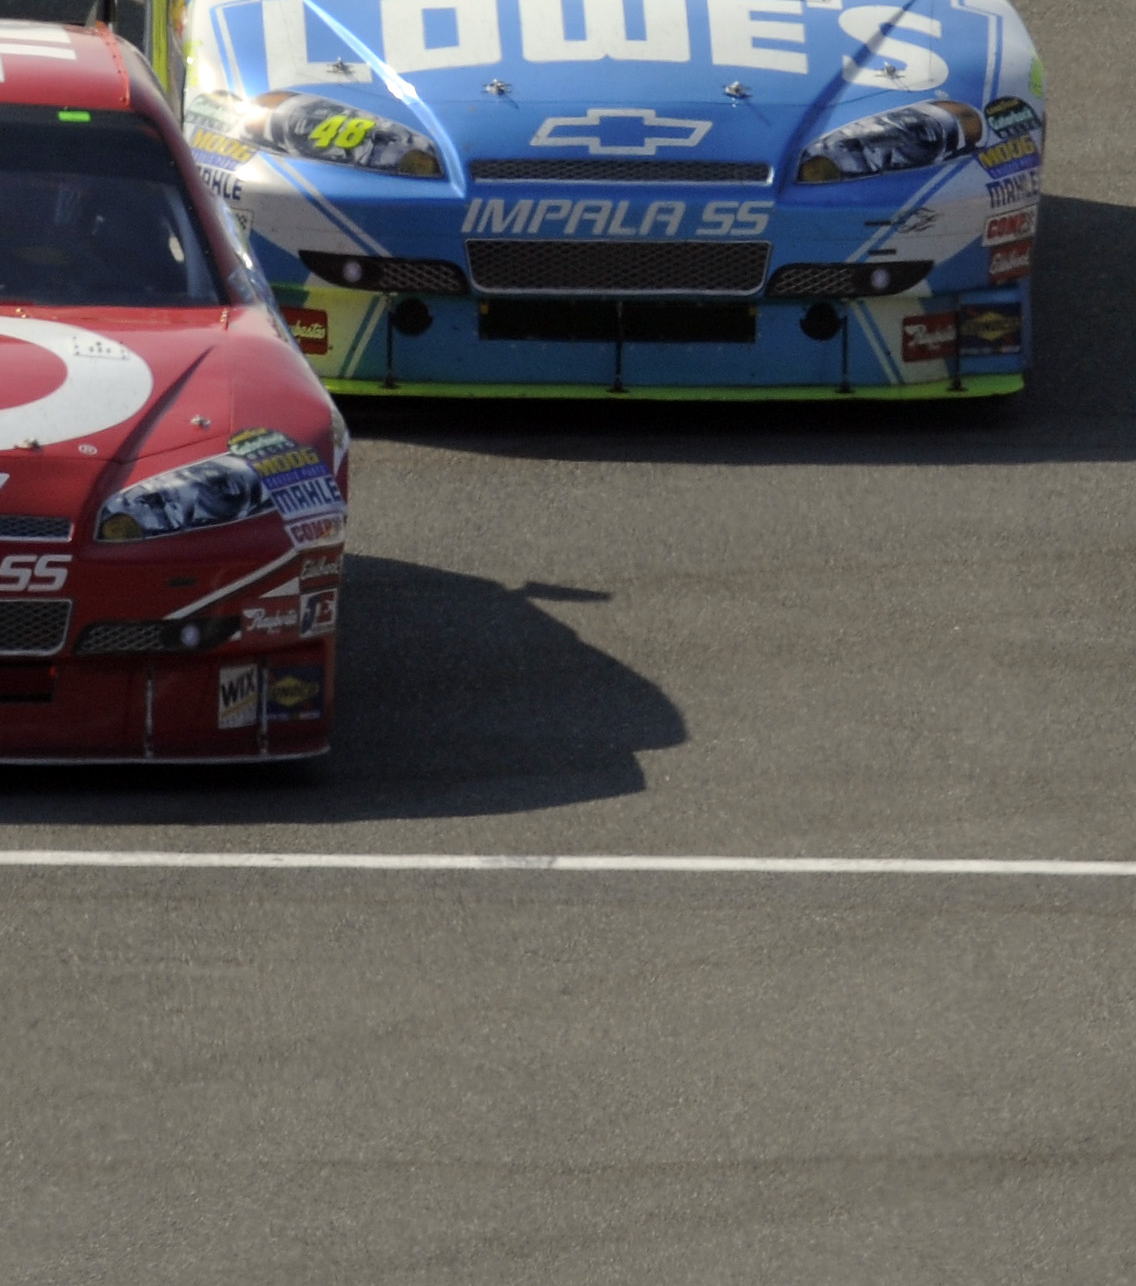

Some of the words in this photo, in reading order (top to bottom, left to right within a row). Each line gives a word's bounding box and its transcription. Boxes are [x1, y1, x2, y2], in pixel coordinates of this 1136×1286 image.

[192, 129, 253, 162] MOOG
[309, 116, 376, 149] 48
[978, 134, 1036, 169] MOOG
[197, 166, 242, 201] AHLE
[461, 198, 686, 235] IMPALA
[695, 200, 774, 236] SS
[253, 446, 321, 477] MOOG
[271, 476, 342, 514] MAHLE
[221, 669, 256, 709] WIX
